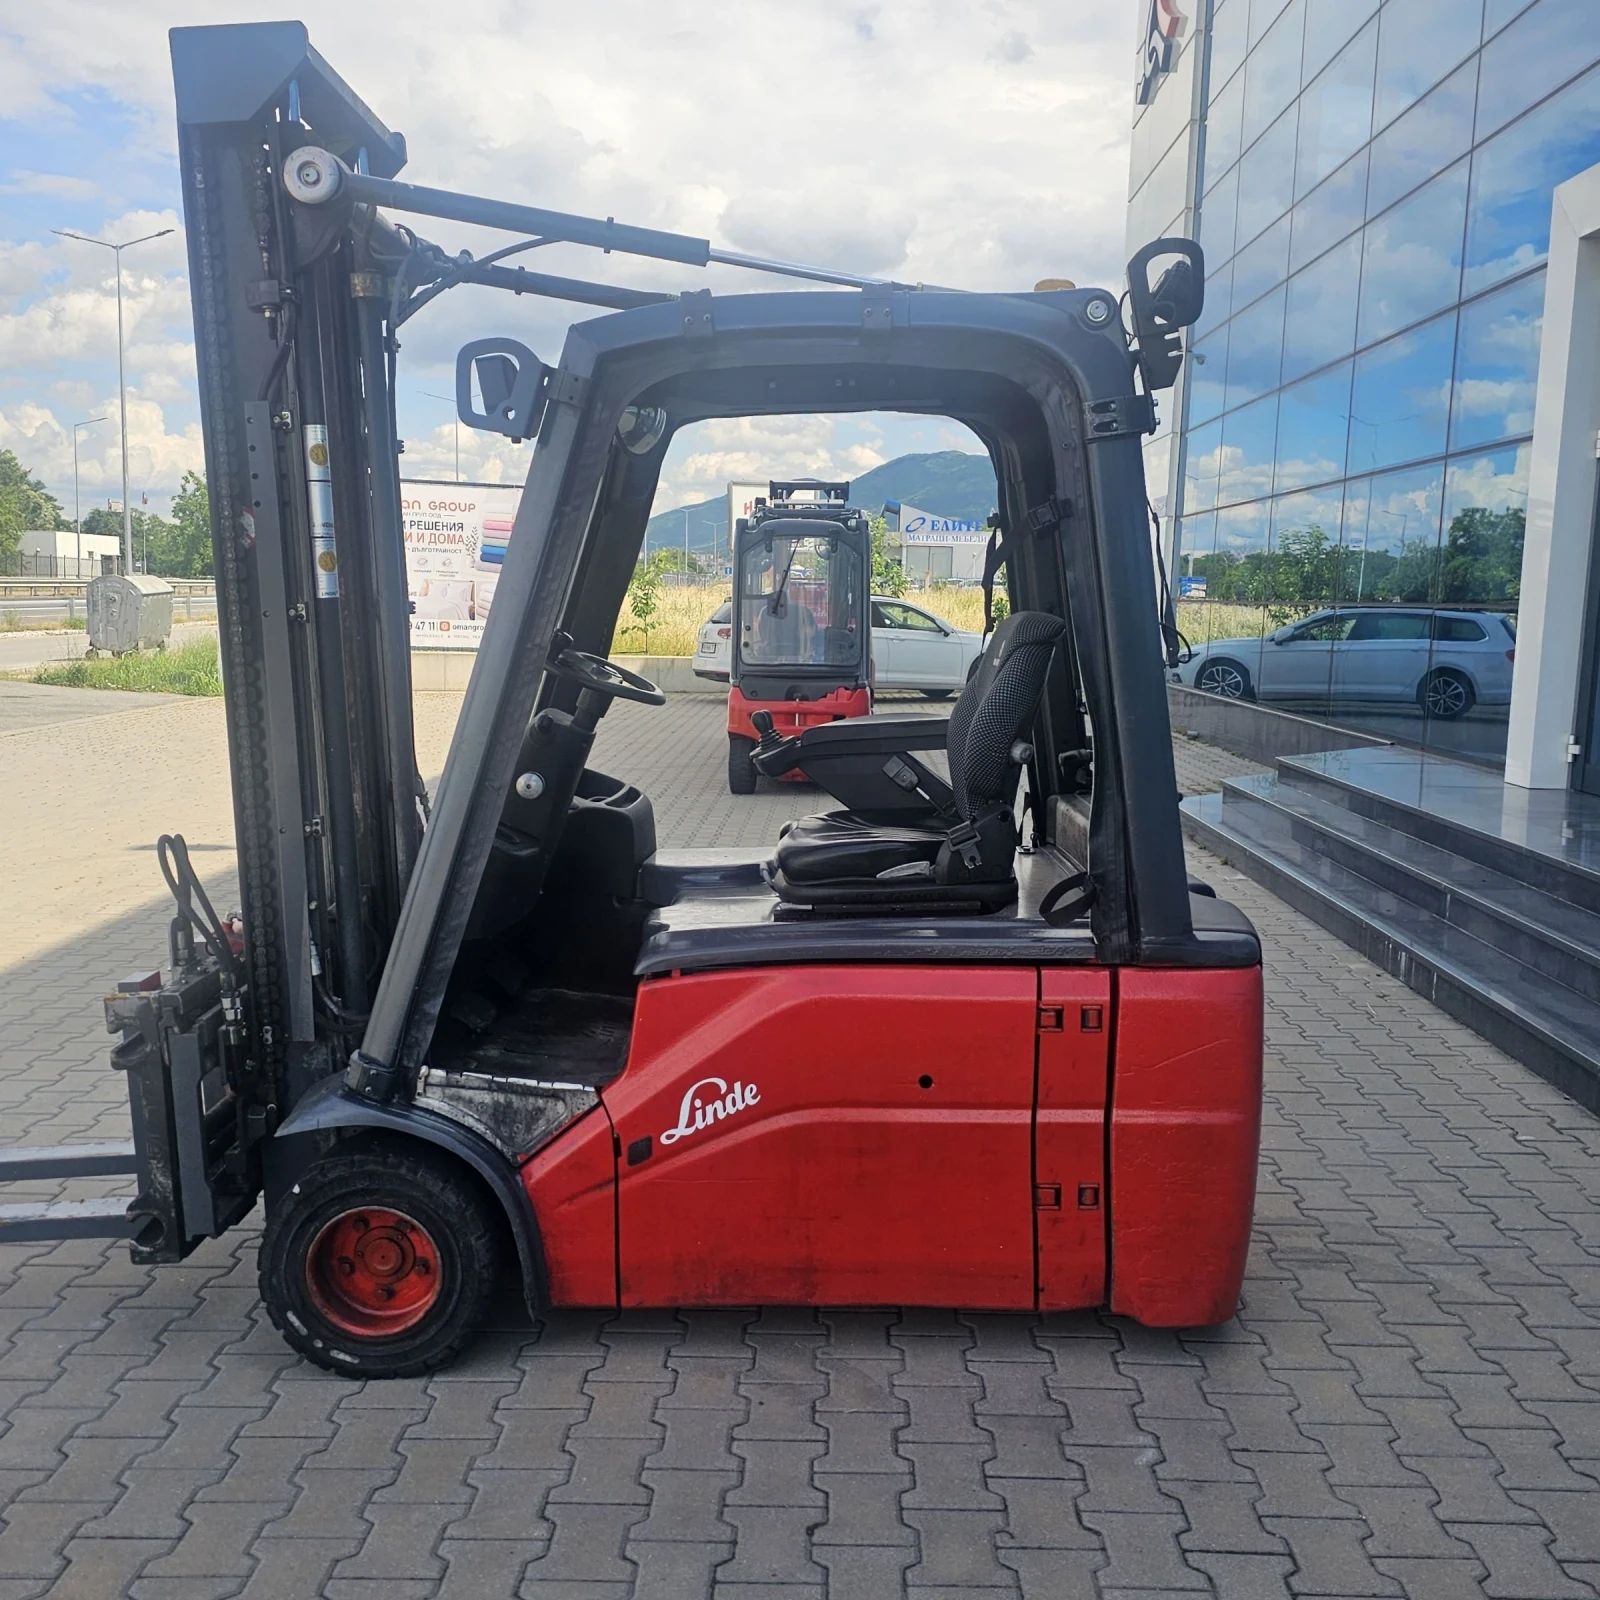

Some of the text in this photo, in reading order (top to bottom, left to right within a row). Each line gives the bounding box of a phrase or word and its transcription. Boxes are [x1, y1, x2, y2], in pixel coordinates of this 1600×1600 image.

[428, 500, 476, 512] GROUP
[409, 520, 464, 532] РЕШЕНИЯ
[416, 532, 425, 543] И
[428, 533, 465, 546] ДОМА
[415, 621, 426, 631] 47
[428, 621, 436, 632] 11
[659, 1077, 761, 1145] Linde
